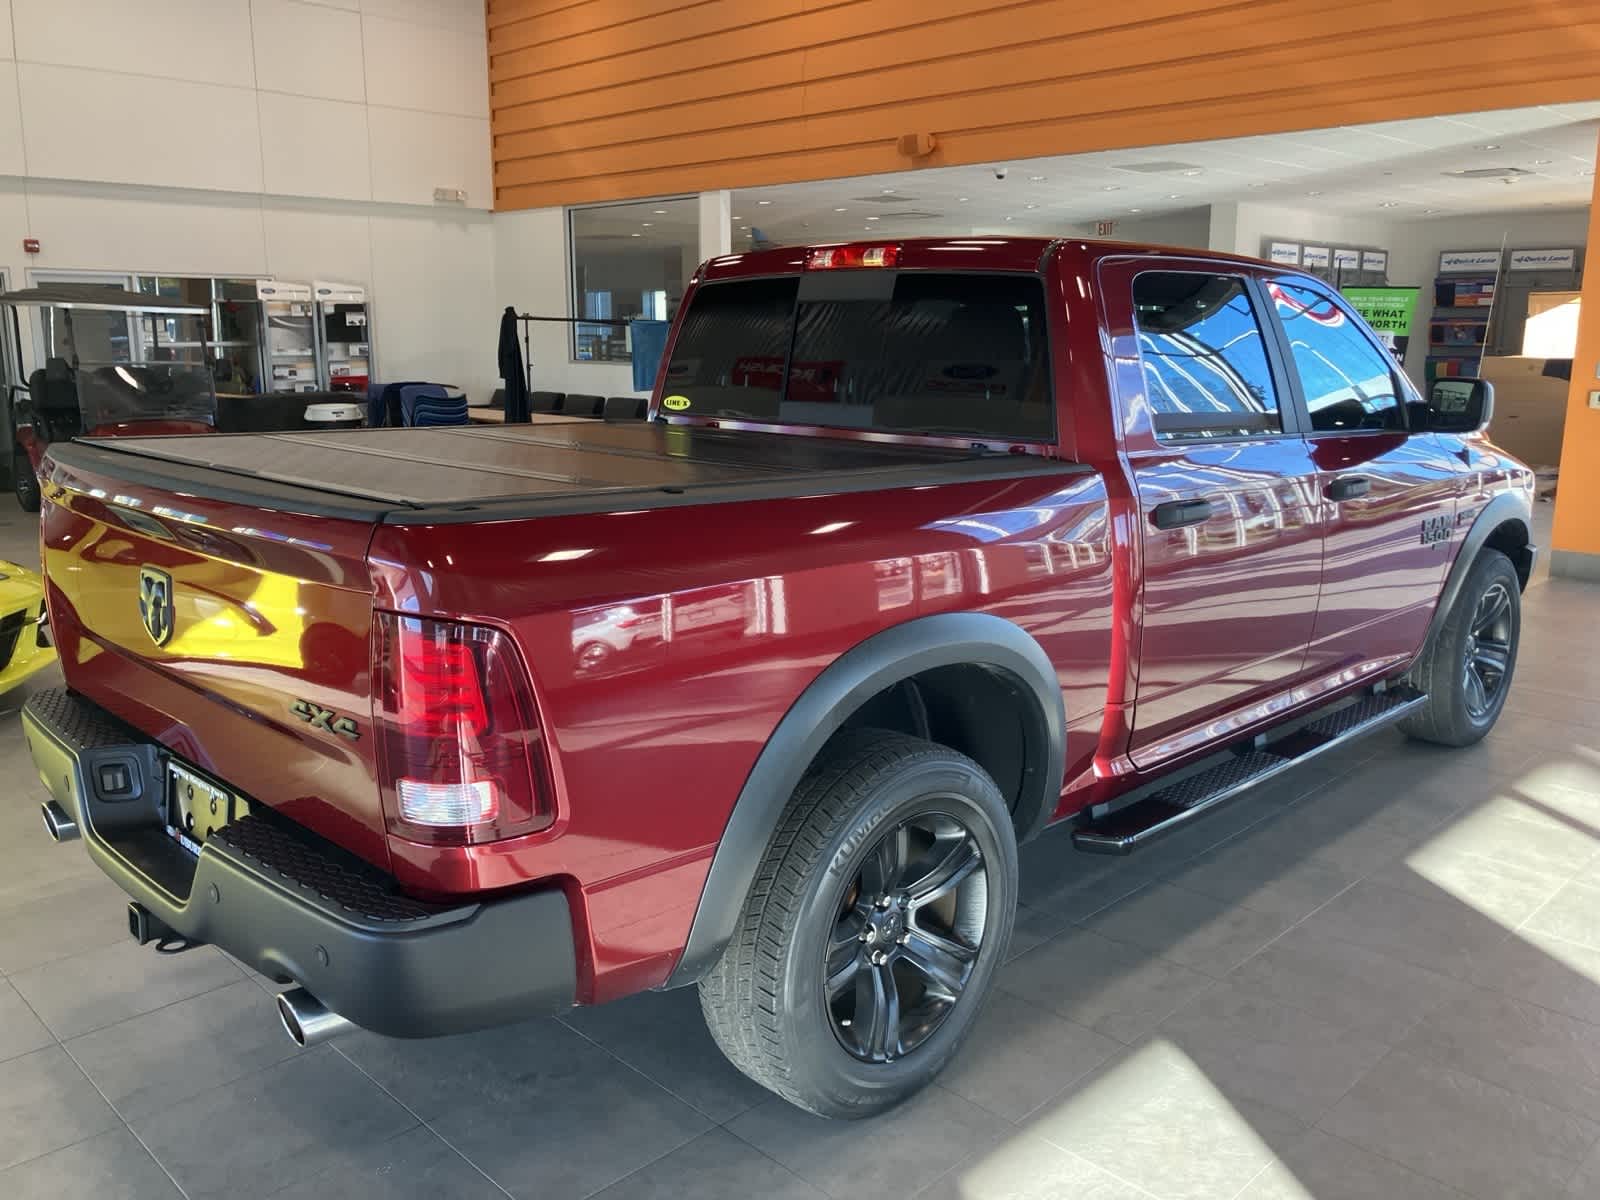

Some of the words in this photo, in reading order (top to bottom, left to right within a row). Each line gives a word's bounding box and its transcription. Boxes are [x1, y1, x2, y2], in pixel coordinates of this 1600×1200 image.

[1373, 309, 1406, 318] WHAT
[1422, 515, 1455, 531] RAM
[1421, 528, 1453, 544] 1500
